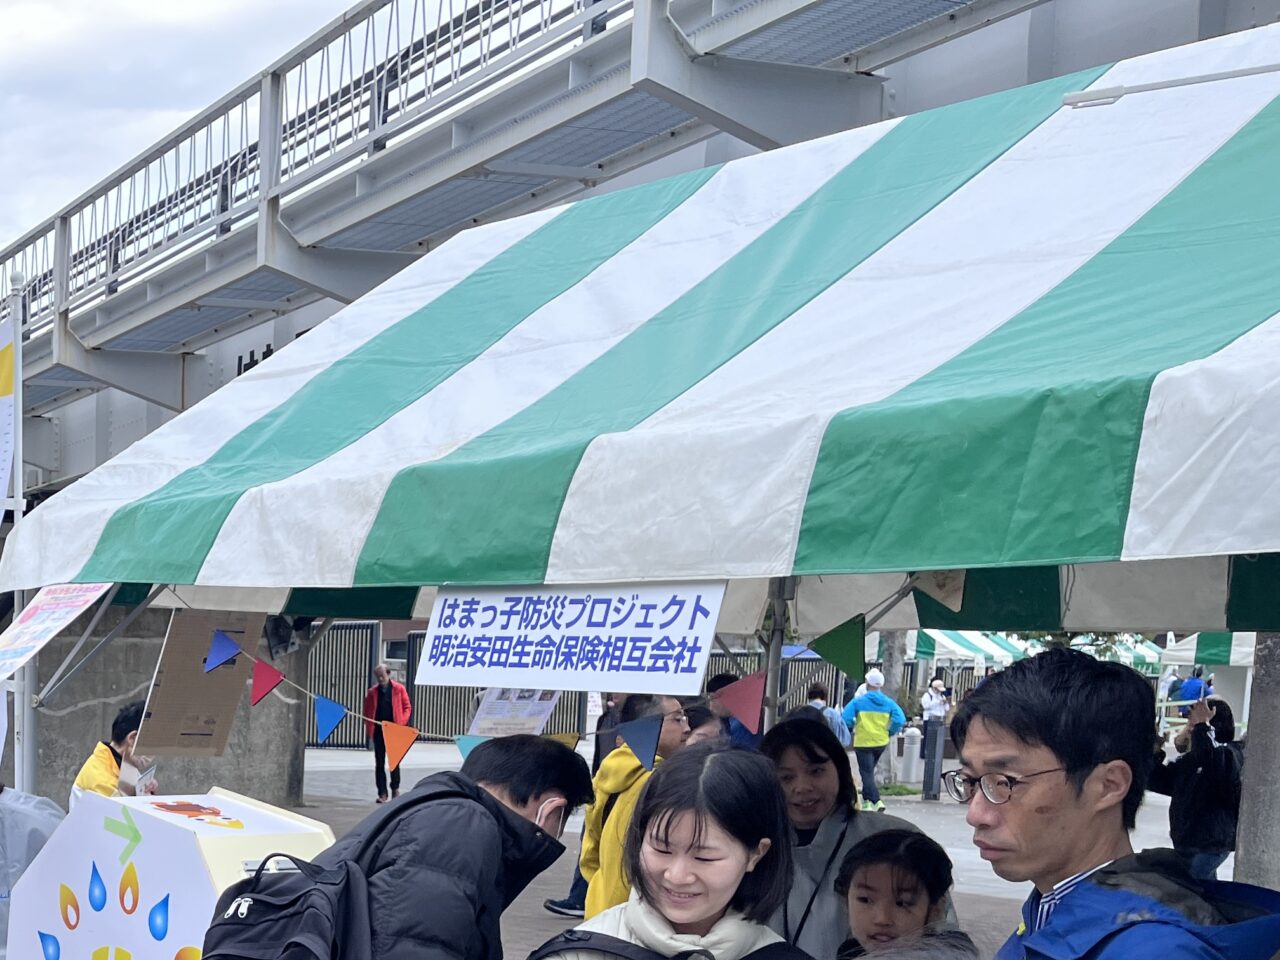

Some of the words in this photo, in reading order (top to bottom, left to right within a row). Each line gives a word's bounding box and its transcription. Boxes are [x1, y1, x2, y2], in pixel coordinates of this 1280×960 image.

[436, 593, 711, 631] はまっ子防災プロジェクト
[428, 634, 702, 674] 明治安田生命保険相互会社
